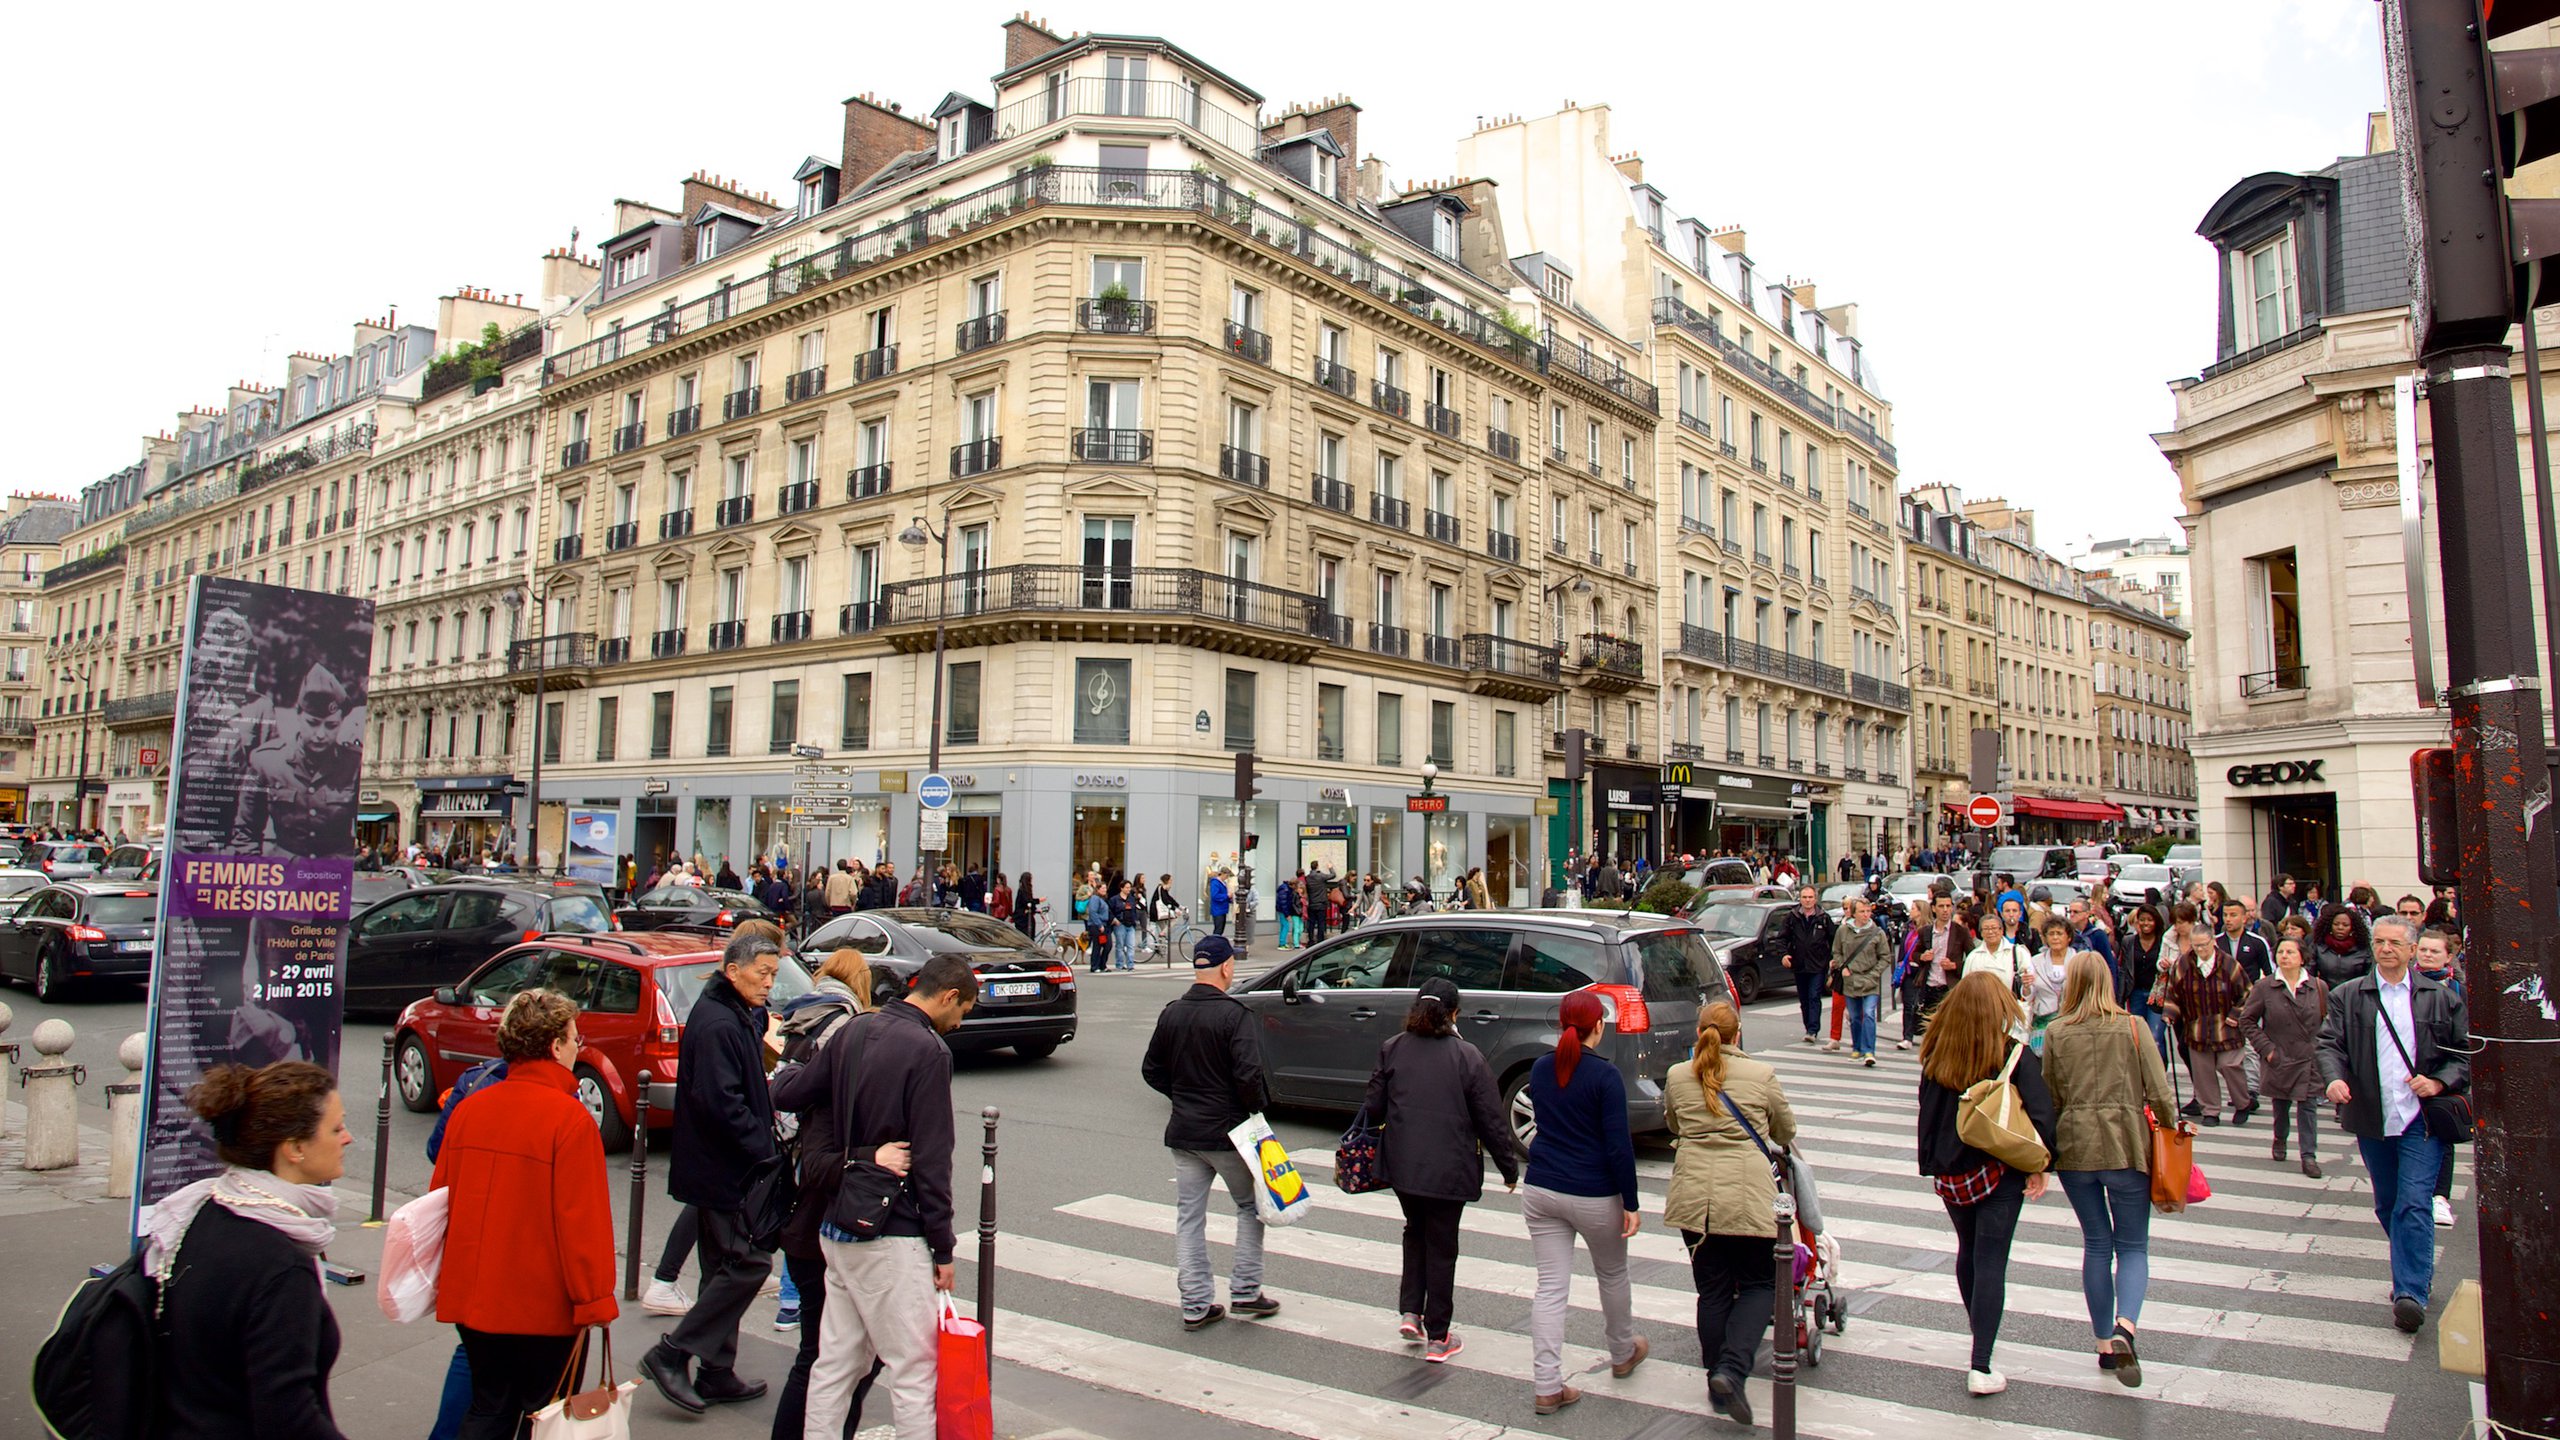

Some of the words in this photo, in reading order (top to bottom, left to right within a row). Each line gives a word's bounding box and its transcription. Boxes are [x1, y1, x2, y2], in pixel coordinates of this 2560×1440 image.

[946, 774, 973, 786] YSHO
[1075, 773, 1128, 788] OYSHO
[2227, 759, 2325, 788] GEOX
[1322, 786, 1346, 798] OYSH
[1608, 789, 1630, 803] LUSH
[1411, 799, 1443, 810] METRO
[185, 861, 285, 886] FEMMES
[297, 870, 342, 880] Exposition
[197, 888, 211, 904] ET
[214, 884, 340, 912] RÉSISTANCE
[291, 925, 322, 936] Grilles
[324, 926, 337, 936] de
[267, 938, 298, 948] l'Hôtel
[300, 938, 313, 948] de
[316, 938, 336, 948] Ville
[295, 951, 308, 961] de
[310, 950, 336, 961] Paris
[281, 965, 301, 979] 29
[304, 964, 334, 979] avril
[253, 984, 263, 998] 2
[265, 983, 293, 1001] juin
[296, 982, 333, 998] 2015
